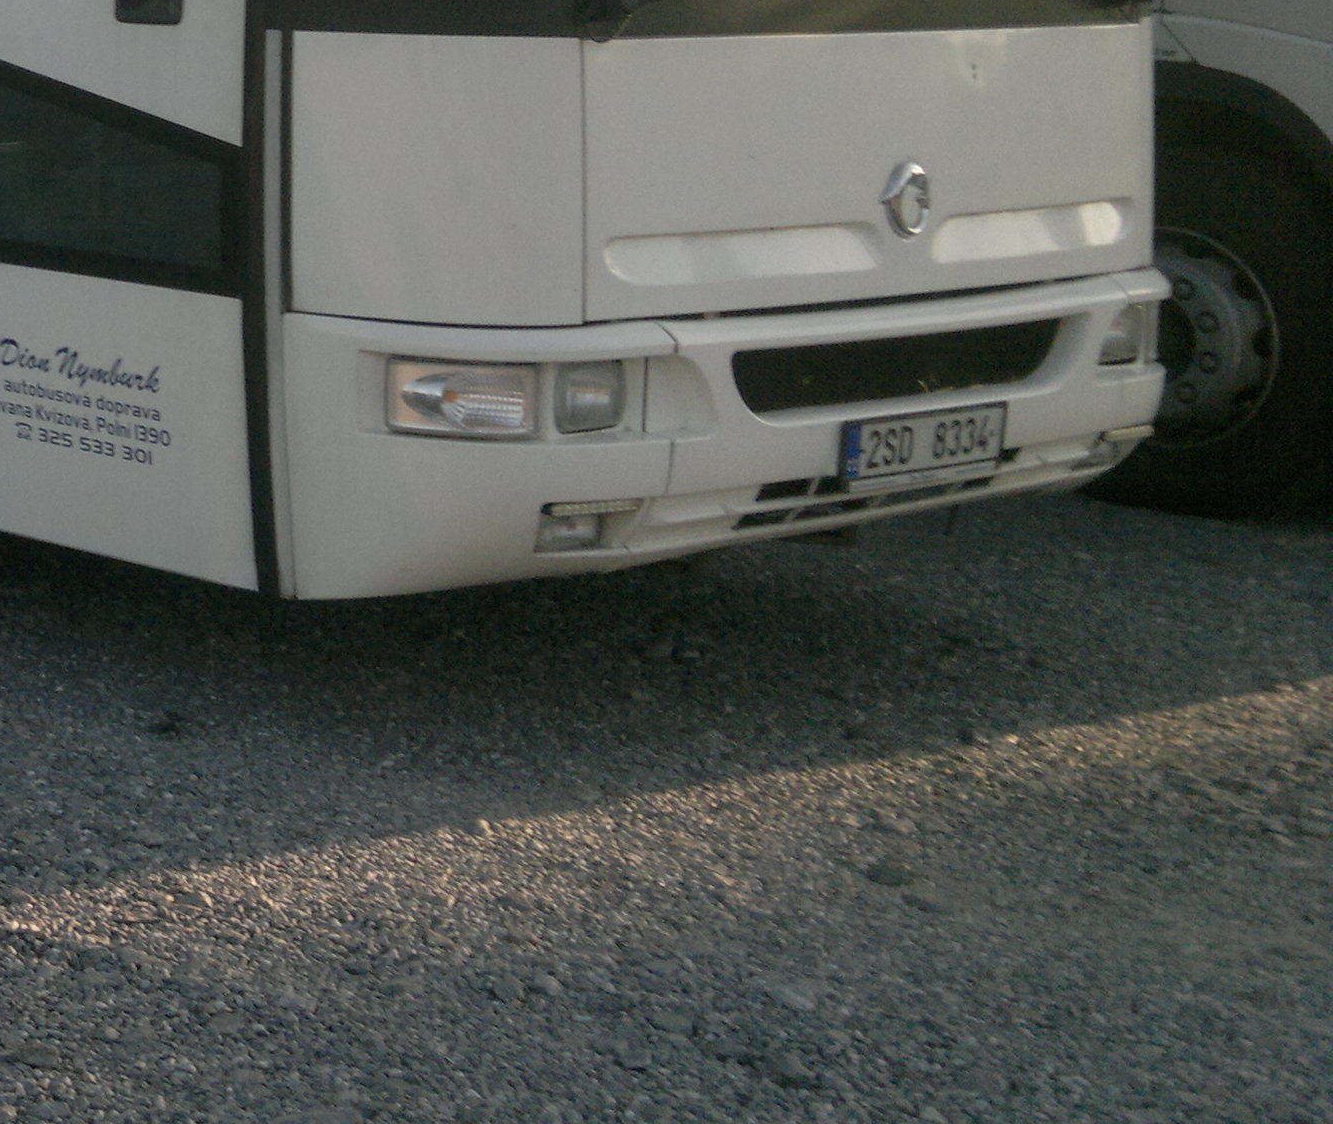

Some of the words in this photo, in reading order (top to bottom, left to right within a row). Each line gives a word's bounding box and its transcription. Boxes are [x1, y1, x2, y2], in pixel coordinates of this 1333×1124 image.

[0, 339, 49, 372] Dion
[56, 347, 160, 393] Nymburk
[96, 395, 161, 422] doprava
[38, 427, 73, 448] 325
[79, 435, 116, 458] 533
[122, 444, 153, 466] 301
[133, 423, 172, 447] 1390
[866, 425, 913, 470] 2SD
[934, 415, 994, 459] 8334
